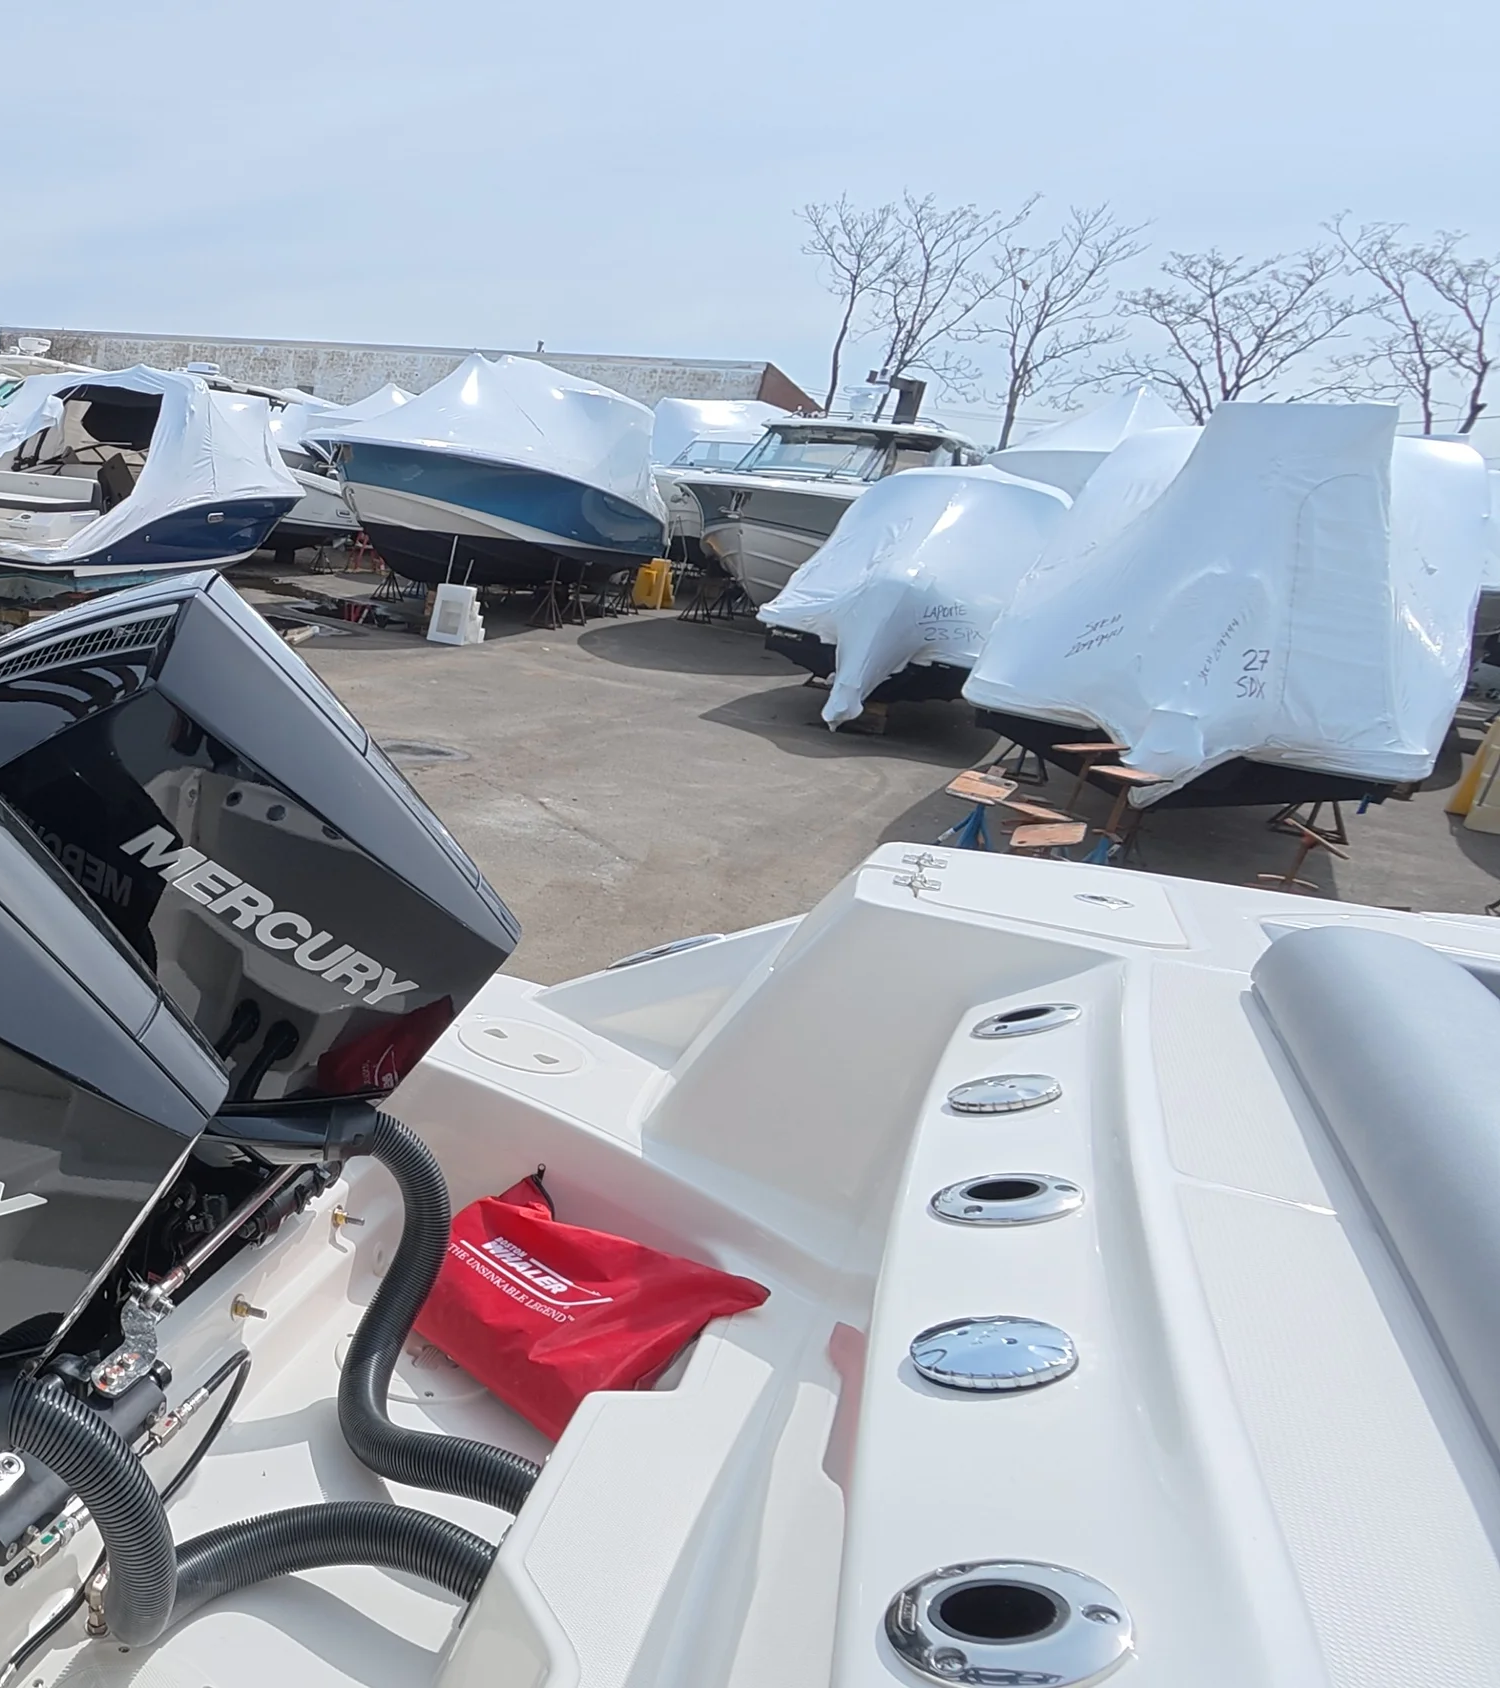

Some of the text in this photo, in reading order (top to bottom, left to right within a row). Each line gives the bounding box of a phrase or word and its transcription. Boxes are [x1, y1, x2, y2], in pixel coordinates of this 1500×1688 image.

[1242, 648, 1270, 672] 27
[1235, 675, 1267, 700] SDX
[119, 824, 420, 1006] MERCURY
[494, 1236, 528, 1258] BOSTON
[448, 1242, 470, 1261] THE
[465, 1257, 529, 1303] UNSINKABLE
[481, 1240, 568, 1295] WHALER
